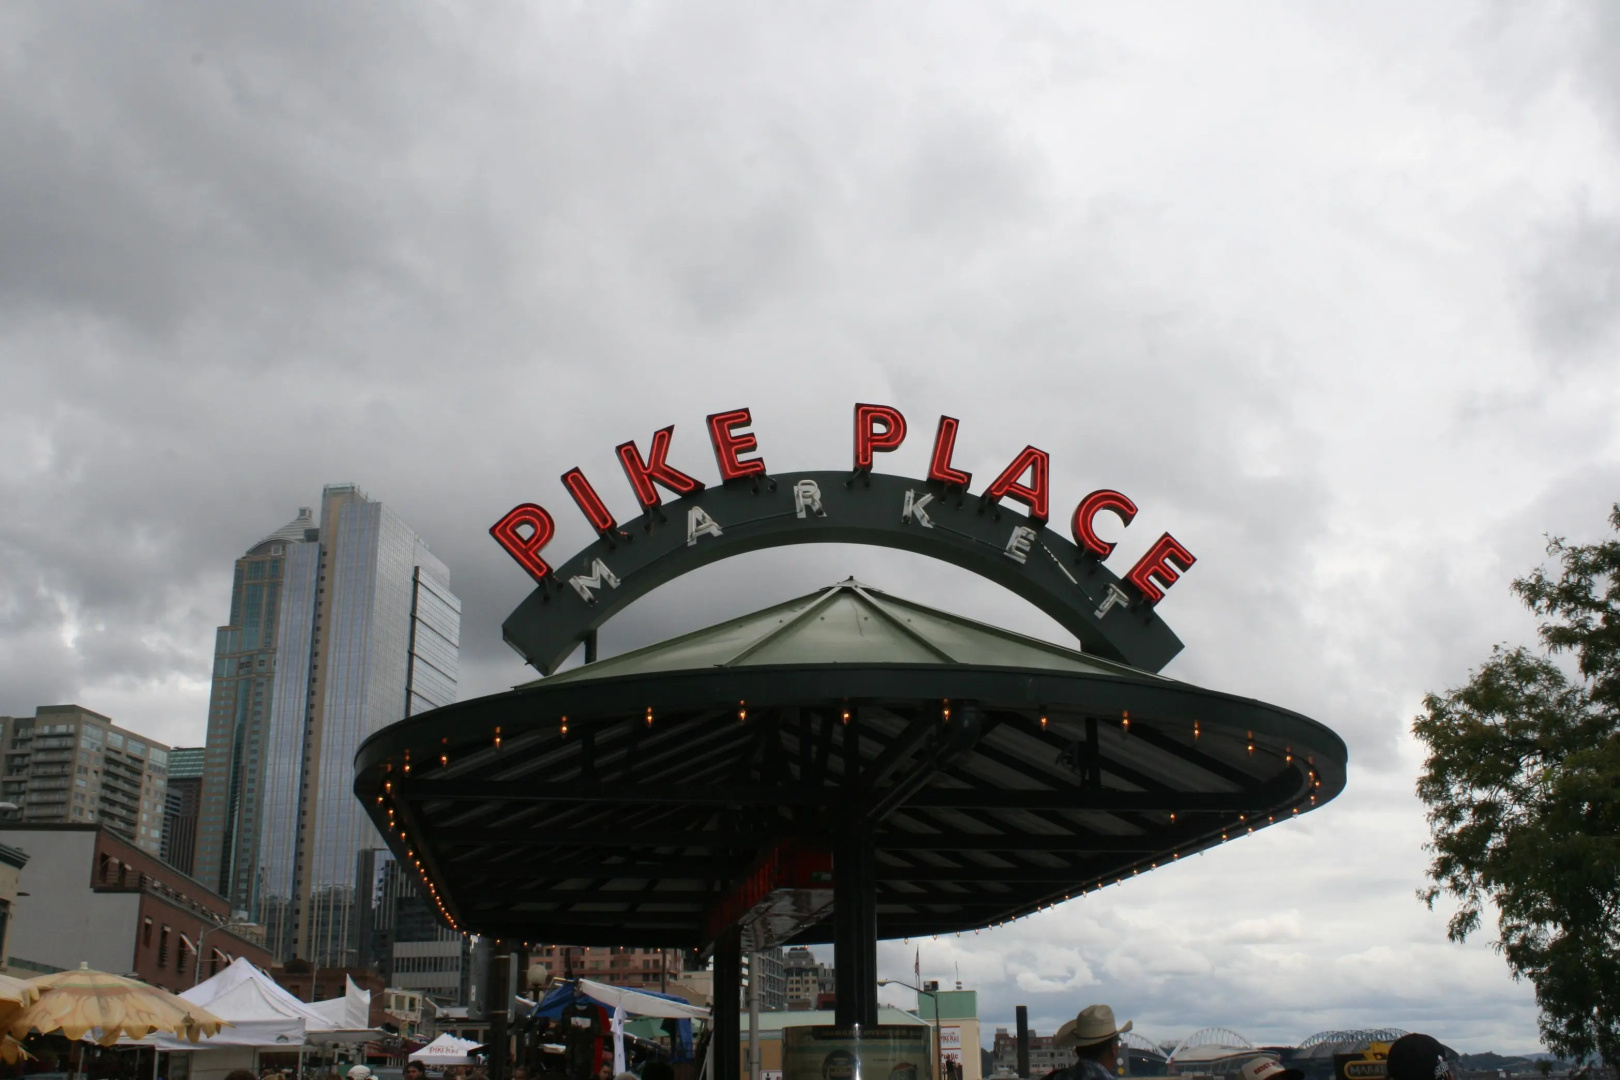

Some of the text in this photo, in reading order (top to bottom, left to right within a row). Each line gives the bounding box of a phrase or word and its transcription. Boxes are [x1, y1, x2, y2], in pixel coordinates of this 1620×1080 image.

[489, 402, 1198, 605] PIKE PLACE
[568, 479, 1130, 619] MARKET
[1349, 1065, 1387, 1075] MARKE
